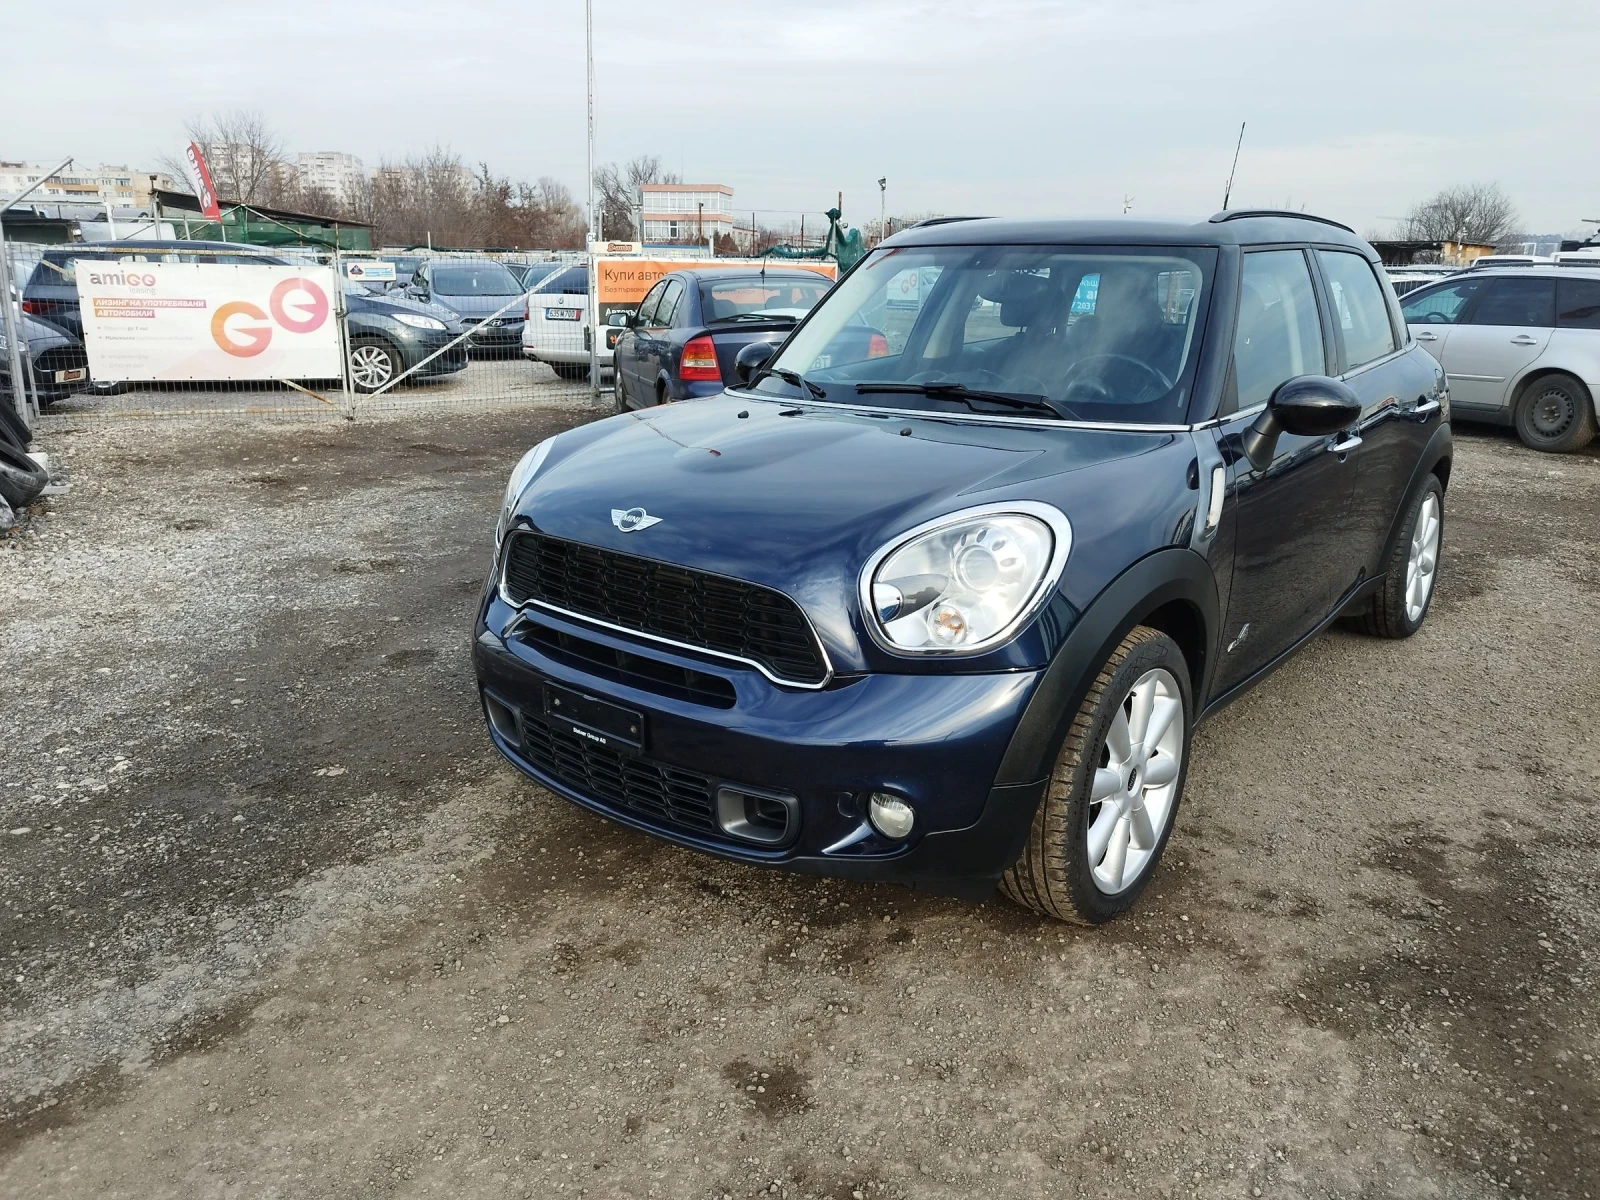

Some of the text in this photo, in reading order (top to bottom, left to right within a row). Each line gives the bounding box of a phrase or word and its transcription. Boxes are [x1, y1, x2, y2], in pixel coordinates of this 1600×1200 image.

[605, 269, 668, 282] Купи авто
[95, 299, 129, 307] ЛИЗИНГ
[605, 308, 638, 317] Автокъ
